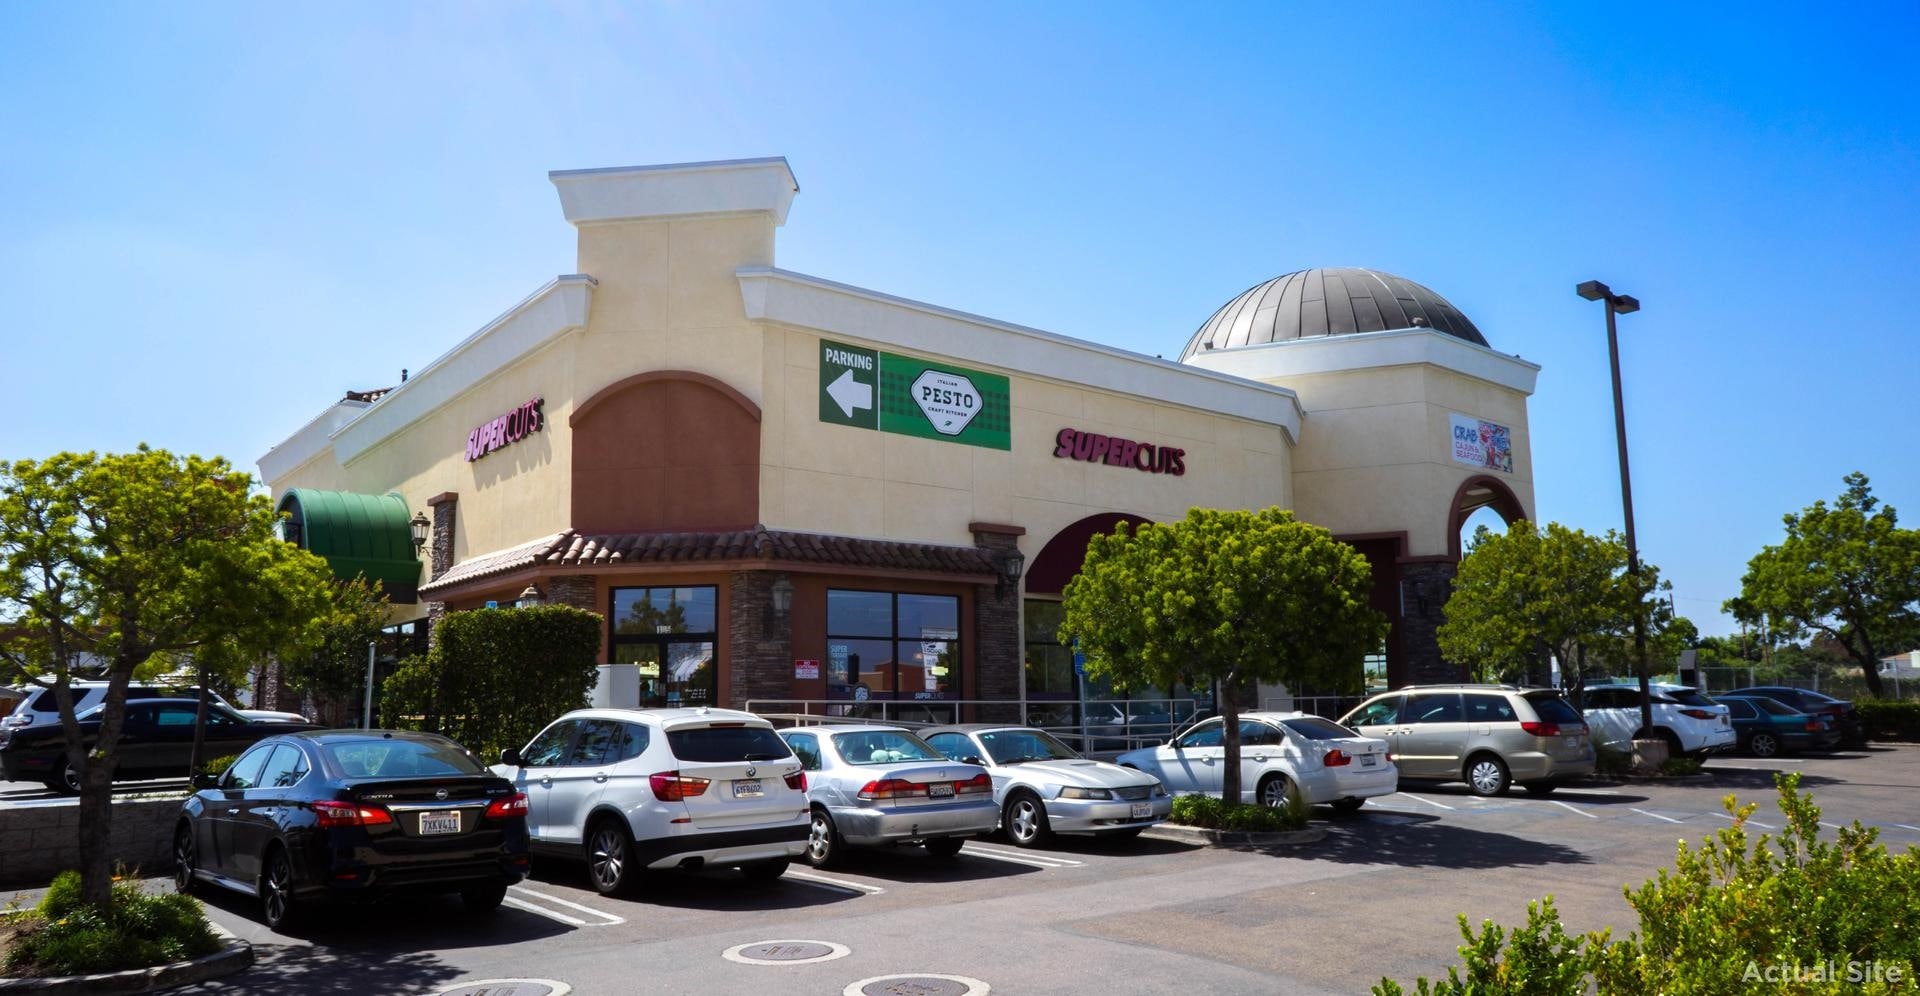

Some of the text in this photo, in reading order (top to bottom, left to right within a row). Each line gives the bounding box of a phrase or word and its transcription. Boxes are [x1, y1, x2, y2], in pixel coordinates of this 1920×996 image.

[825, 348, 873, 371] PARKING
[922, 386, 974, 408] PESTO
[927, 406, 945, 414] CRAFT
[464, 397, 544, 462] SUPERCUTS
[1454, 425, 1478, 442] CRAB
[1053, 428, 1186, 476] SUPERCUTS
[423, 819, 457, 832] 7XKV411
